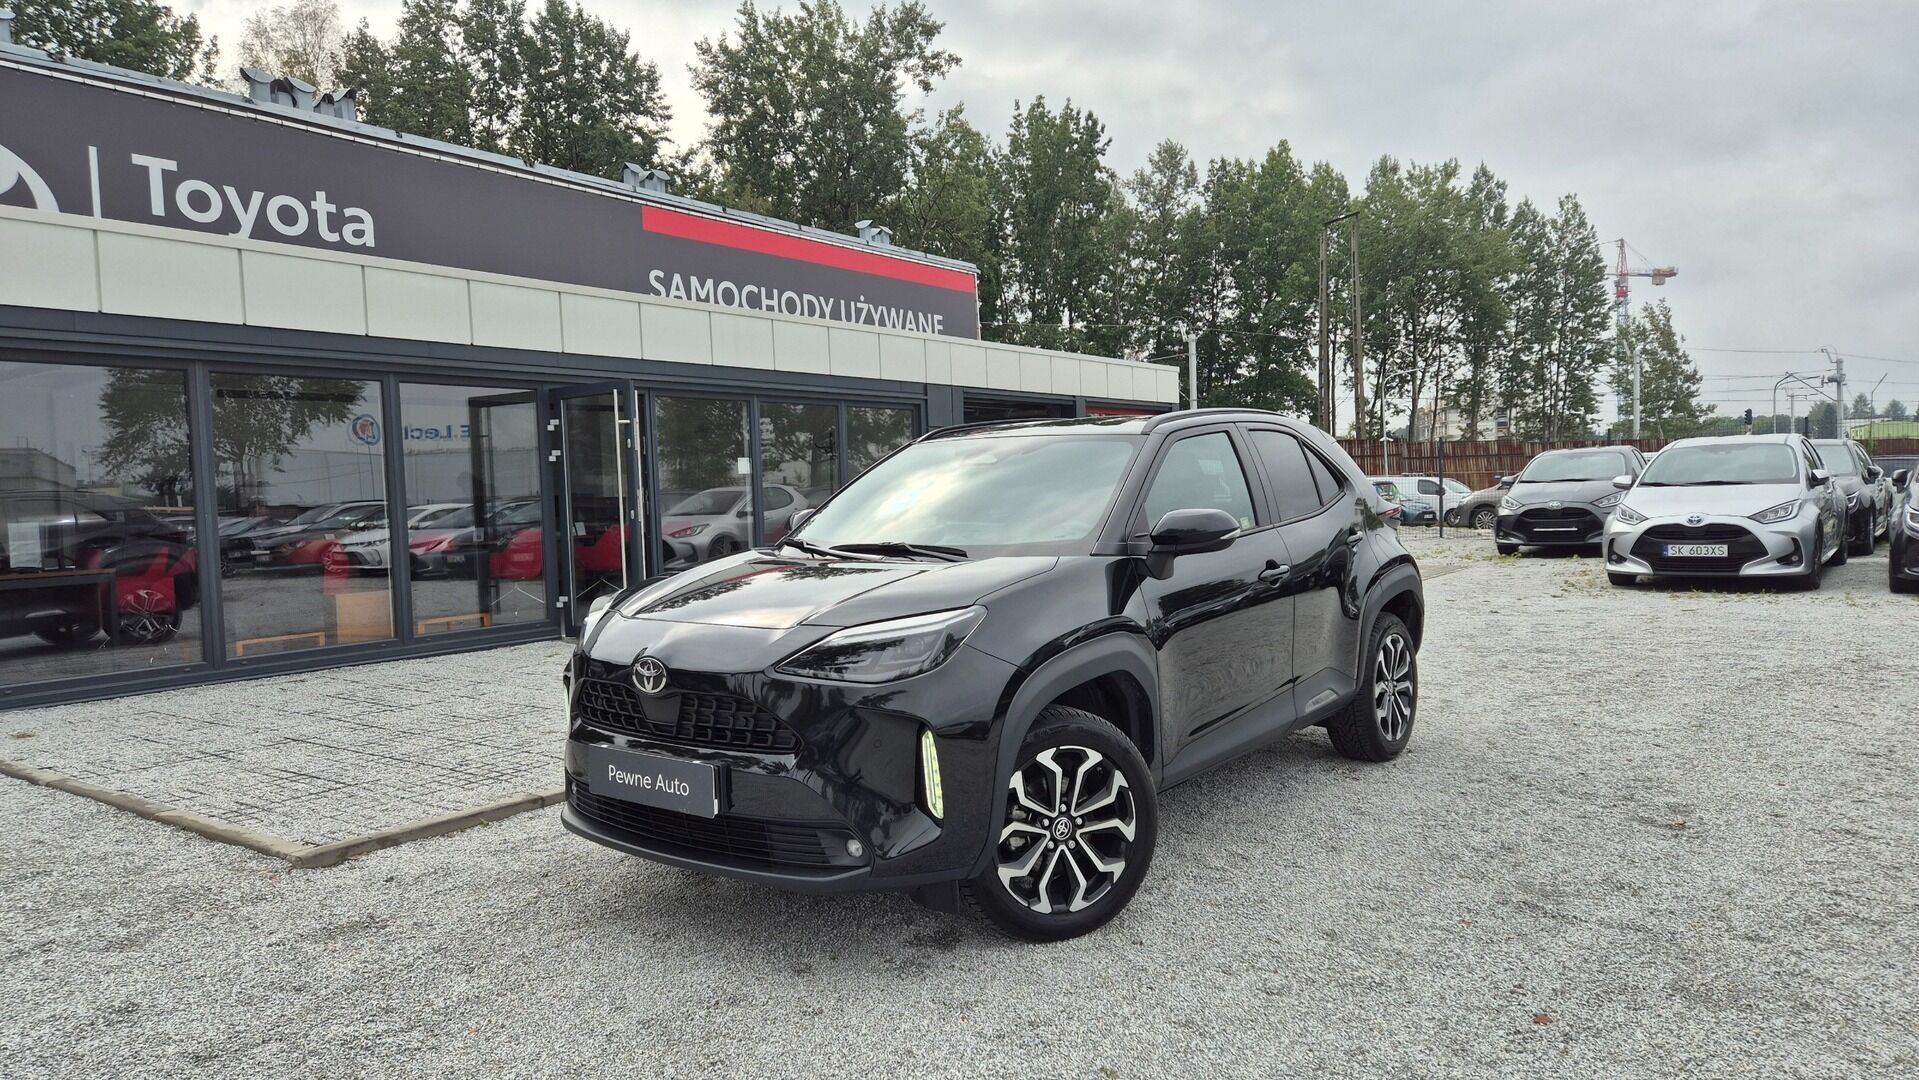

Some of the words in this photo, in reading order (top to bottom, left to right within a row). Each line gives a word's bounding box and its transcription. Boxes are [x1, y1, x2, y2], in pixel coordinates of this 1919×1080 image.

[131, 153, 375, 247] Toyota
[649, 269, 835, 320] SAMOCHODY
[840, 295, 943, 334] UŻYWANE
[1670, 545, 1684, 556] SK
[1689, 545, 1725, 556] 603XS
[609, 764, 652, 789] Pewne
[655, 773, 690, 796] Auto
